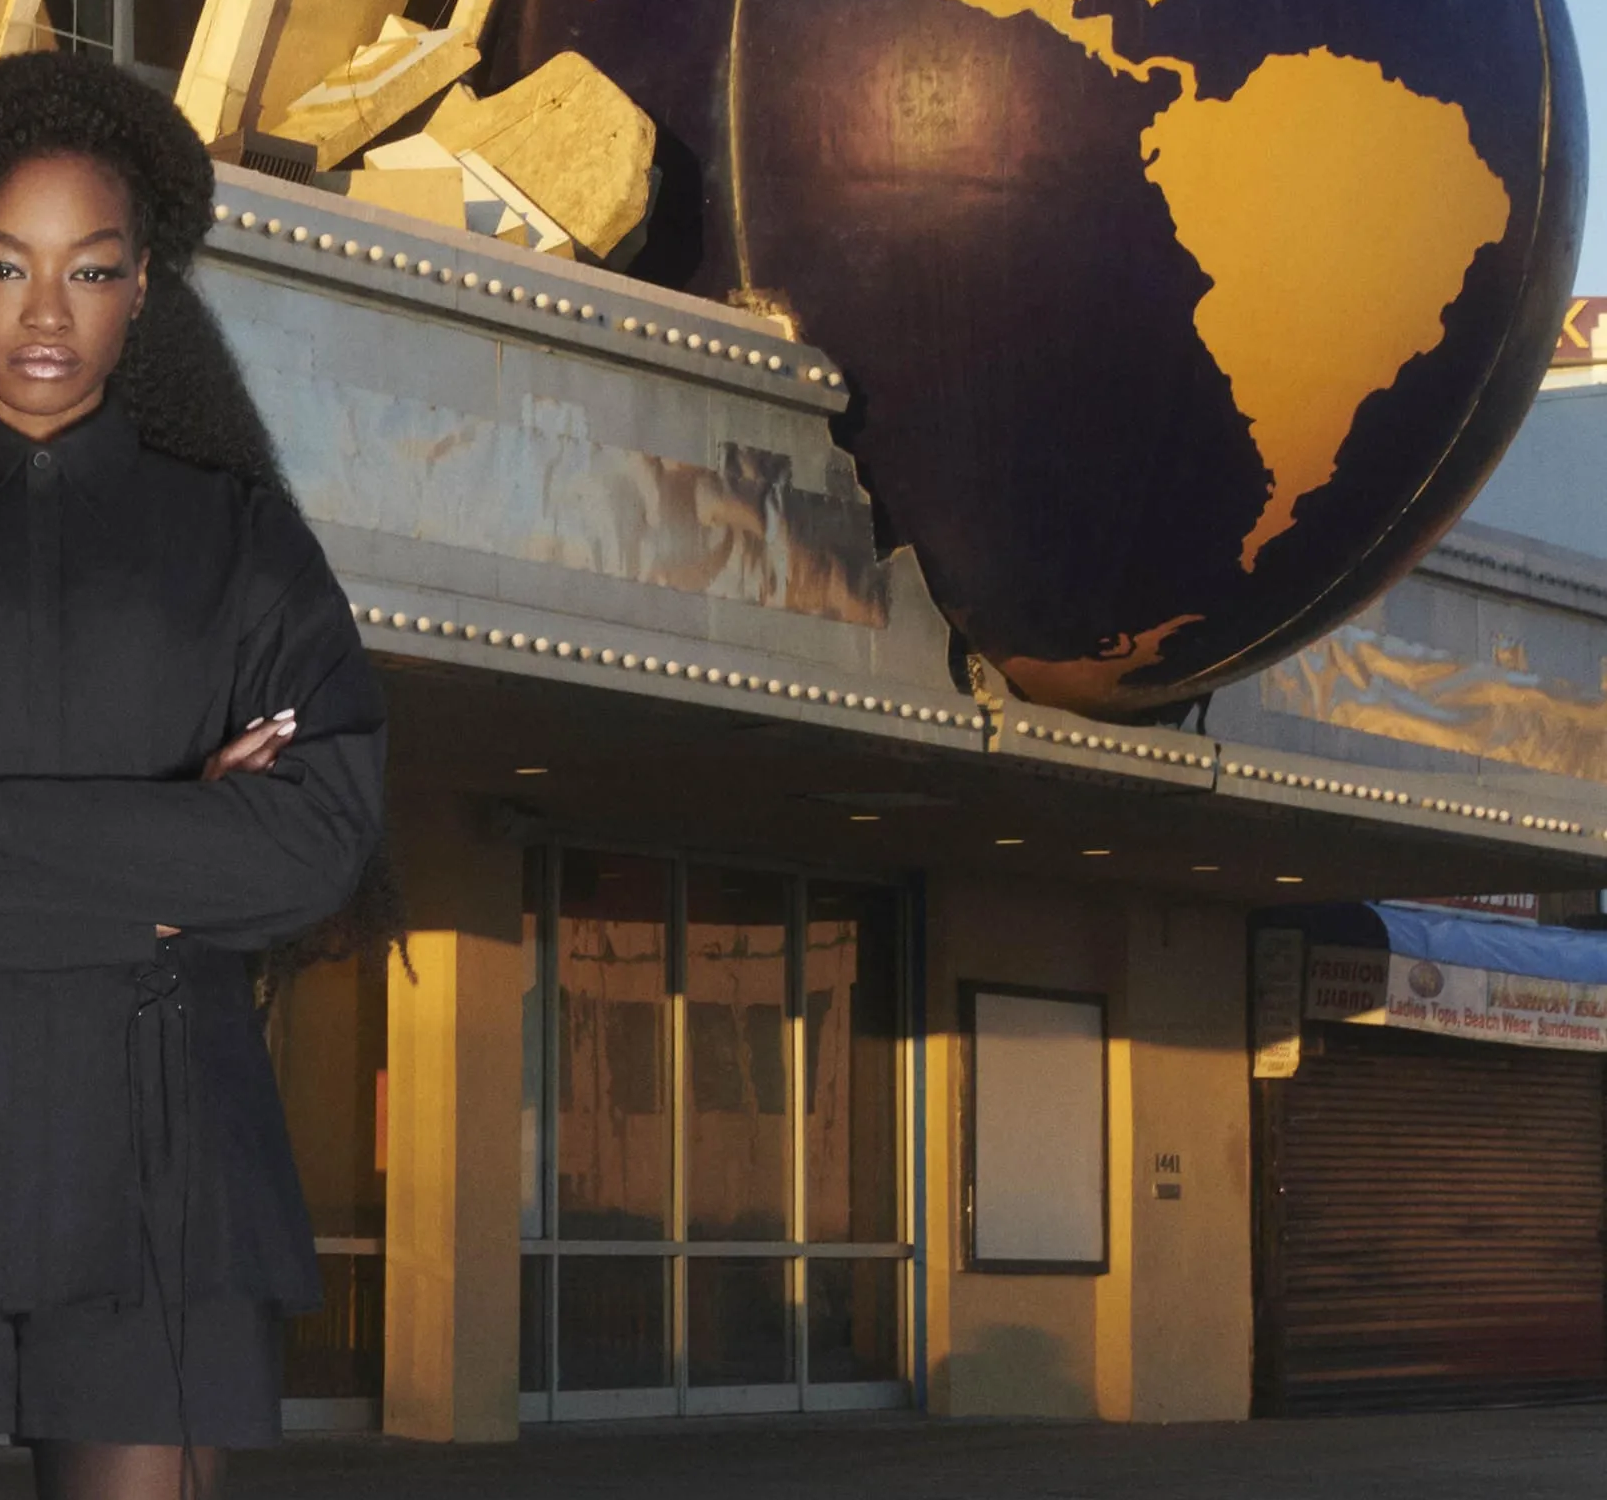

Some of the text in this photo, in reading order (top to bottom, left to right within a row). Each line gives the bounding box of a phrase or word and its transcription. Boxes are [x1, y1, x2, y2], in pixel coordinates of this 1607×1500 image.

[1389, 994, 1427, 1021] Ladies
[1431, 1001, 1461, 1028] Tops,
[1464, 1006, 1500, 1030] Beach
[1502, 1011, 1533, 1036] Wear,
[1155, 1153, 1180, 1173] 1441
